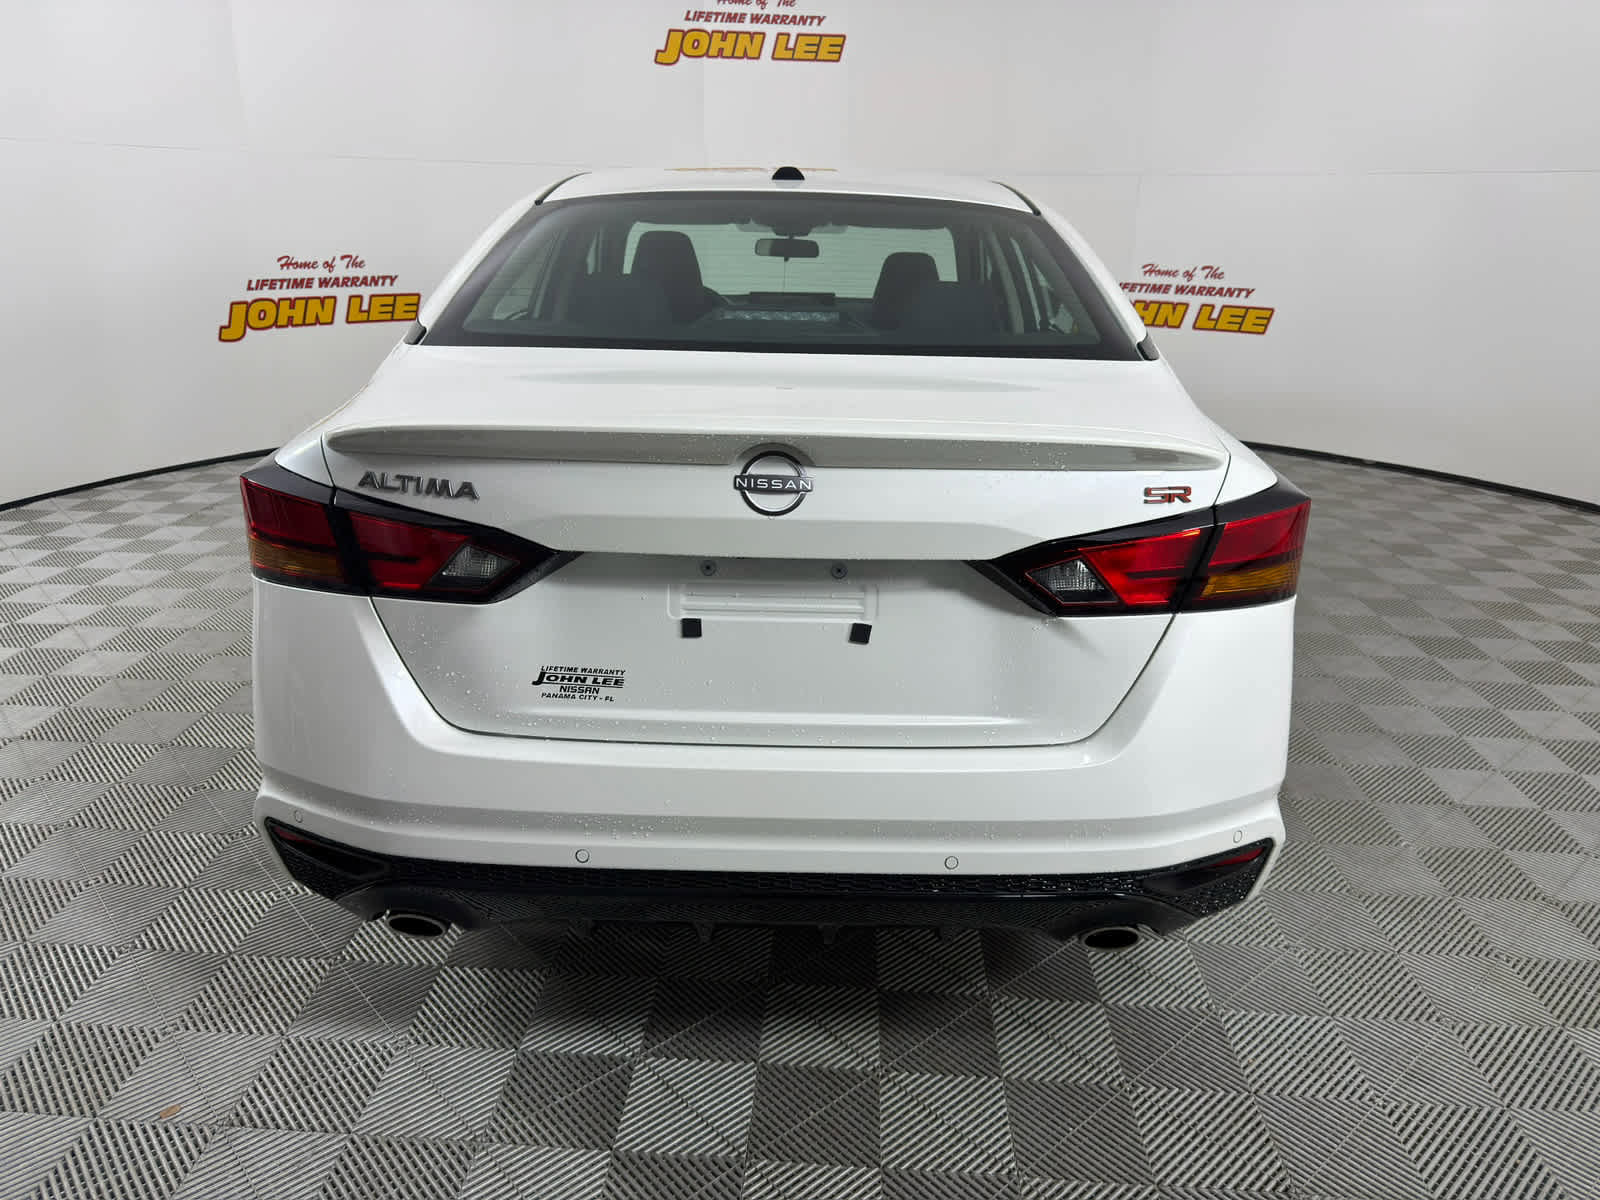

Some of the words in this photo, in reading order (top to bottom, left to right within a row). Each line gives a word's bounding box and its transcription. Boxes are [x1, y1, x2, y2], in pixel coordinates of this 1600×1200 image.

[684, 10, 746, 24] LIFETIME
[749, 13, 827, 27] WARRANTY
[654, 28, 766, 65] JOHN
[771, 32, 846, 63] LEE
[277, 255, 319, 270] Home
[322, 256, 336, 273] of
[340, 254, 366, 269] The
[1142, 263, 1179, 278] Home
[1182, 266, 1198, 282] of
[1201, 265, 1225, 280] The
[246, 277, 314, 291] LIFETIME
[316, 274, 399, 289] WARRANTY
[1119, 282, 1173, 295] FETIME
[1175, 284, 1255, 299] WARRANTY
[218, 295, 337, 342] JOHN
[345, 293, 421, 324] LEE
[1131, 299, 1189, 329] HN
[1192, 303, 1275, 335] LEE
[357, 470, 480, 500] ALTIMA
[735, 478, 812, 490] NISSAN
[1144, 486, 1192, 504] SR
[531, 671, 588, 686] JOHN
[592, 677, 625, 686] LEE
[540, 665, 579, 673] LIFETIME
[580, 667, 626, 675] WARRANTY
[541, 692, 576, 700] PANAMA
[559, 685, 600, 695] NISSAN
